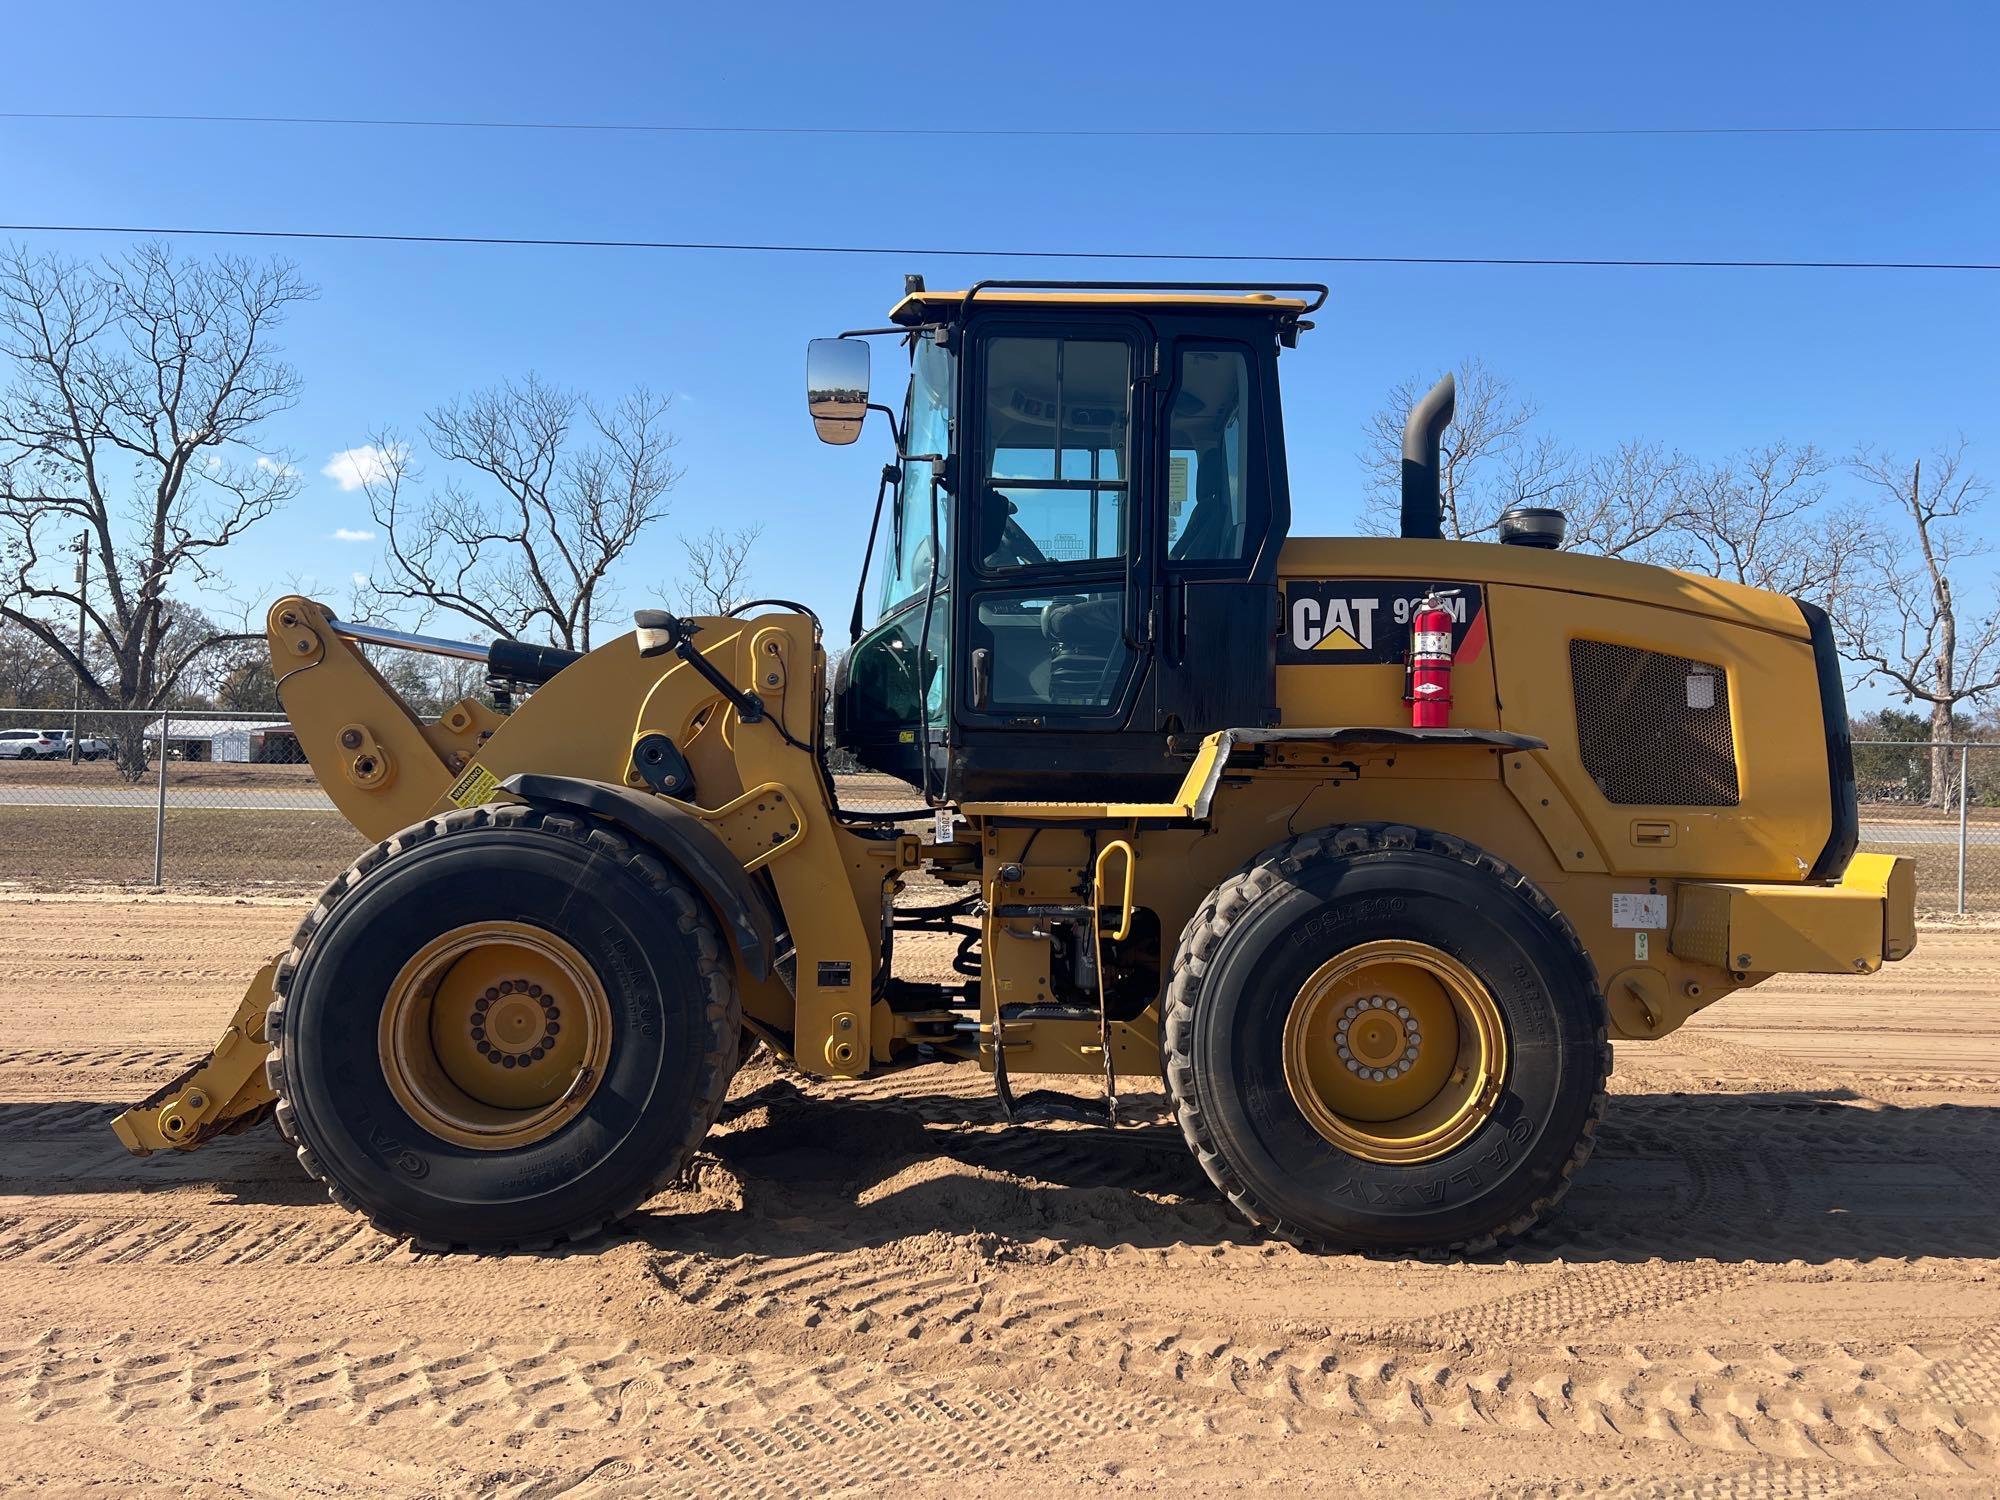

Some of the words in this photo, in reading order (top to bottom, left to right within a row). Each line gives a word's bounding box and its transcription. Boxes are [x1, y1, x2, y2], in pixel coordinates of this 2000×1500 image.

[1293, 598, 1379, 650] CAT
[452, 767, 483, 799] WARNING
[1330, 1115, 1535, 1206] GALAXY
